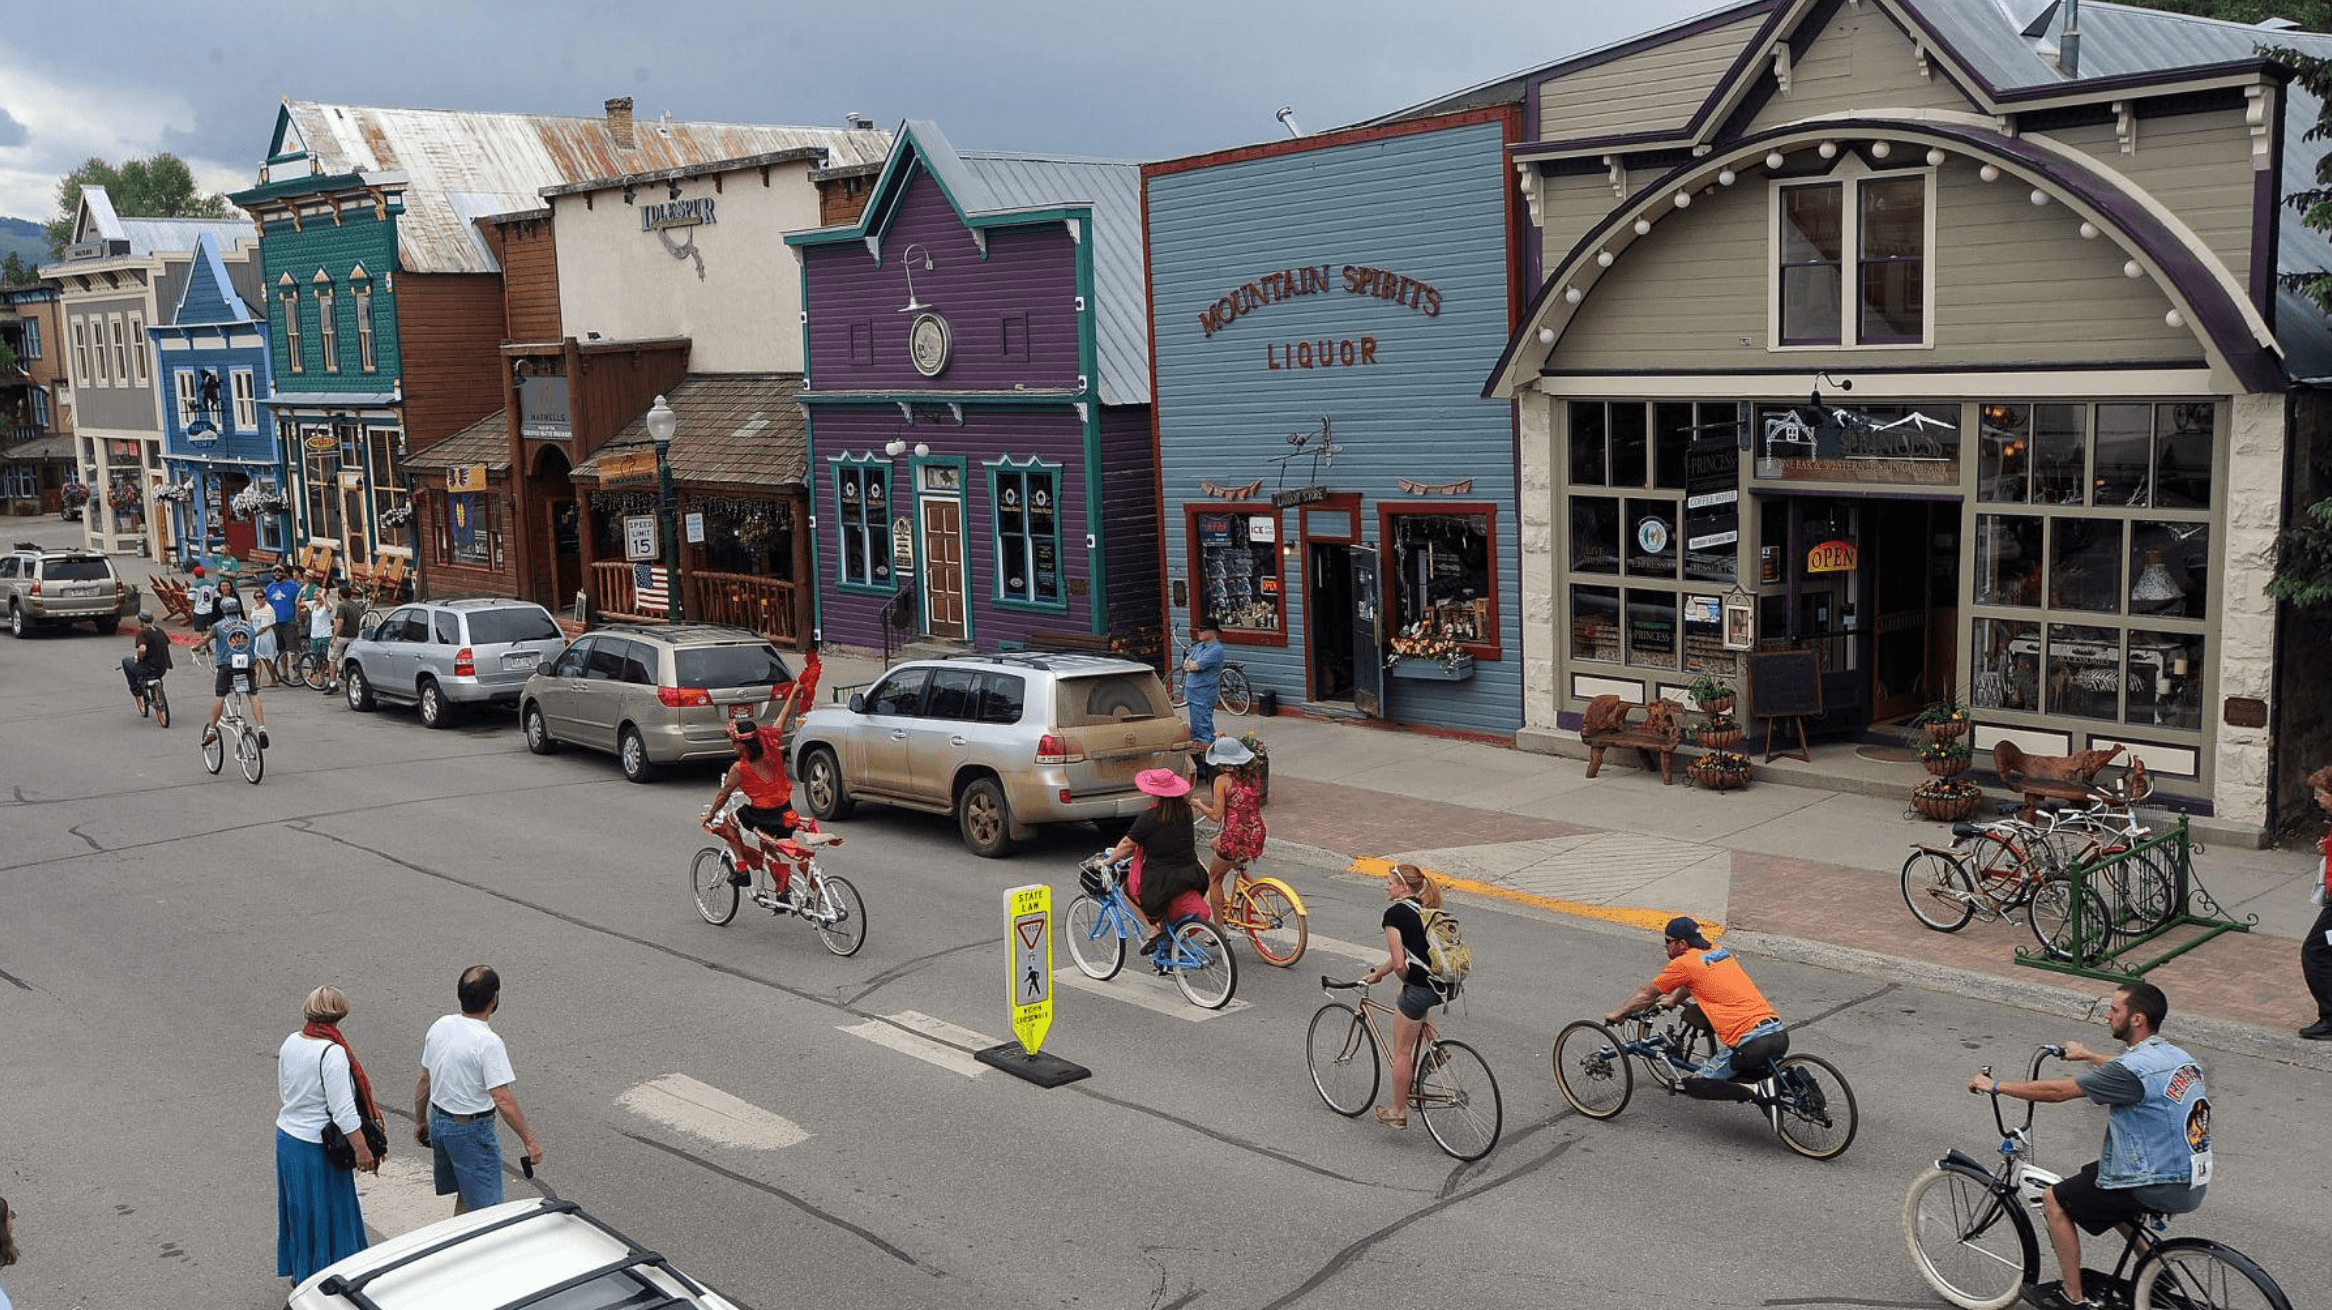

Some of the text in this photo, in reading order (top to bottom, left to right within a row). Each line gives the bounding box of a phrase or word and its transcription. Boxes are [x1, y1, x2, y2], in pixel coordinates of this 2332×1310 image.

[1198, 264, 1442, 338] MOUNTAIN SPIRITS
[1267, 335, 1377, 370] LIQUOR
[1691, 452, 1735, 475] PRINCESS
[1903, 462, 1948, 475] COMPANY
[1251, 526, 1264, 534] ICE
[633, 539, 651, 554] 15
[1811, 547, 1855, 568] OPEN
[1633, 630, 1670, 642] PRINCESS
[1018, 890, 1043, 902] STATE
[1021, 902, 1039, 913] LAW
